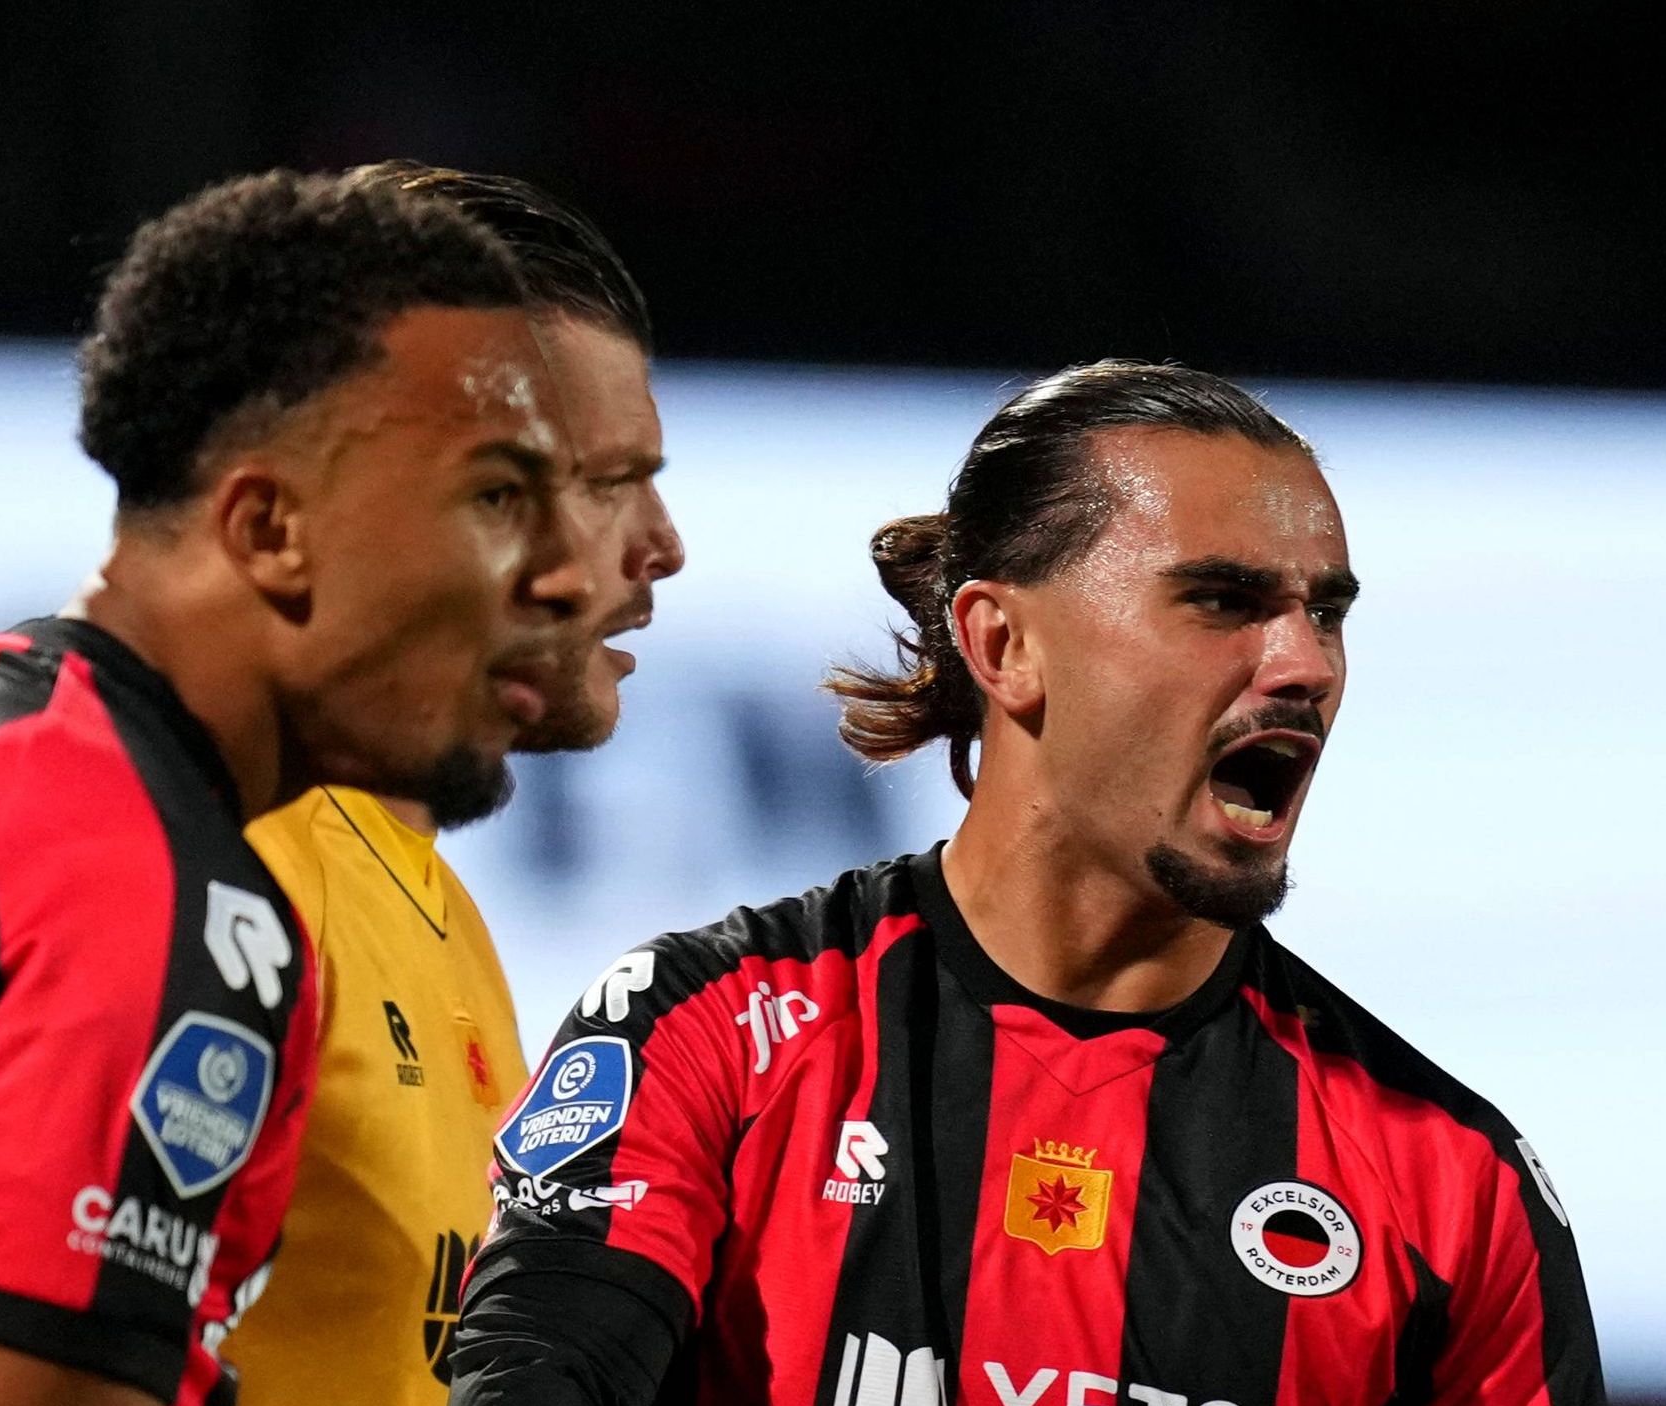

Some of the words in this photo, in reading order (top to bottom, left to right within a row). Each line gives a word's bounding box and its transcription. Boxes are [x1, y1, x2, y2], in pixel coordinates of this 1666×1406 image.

[517, 1124, 593, 1154] LOTERIJ
[520, 1105, 614, 1137] VRIENDEN
[821, 1179, 885, 1206] ROBEY
[71, 1185, 198, 1267] CARU
[1250, 1190, 1345, 1233] EXCELSIOR
[1246, 1247, 1341, 1287] ROTTERDAM
